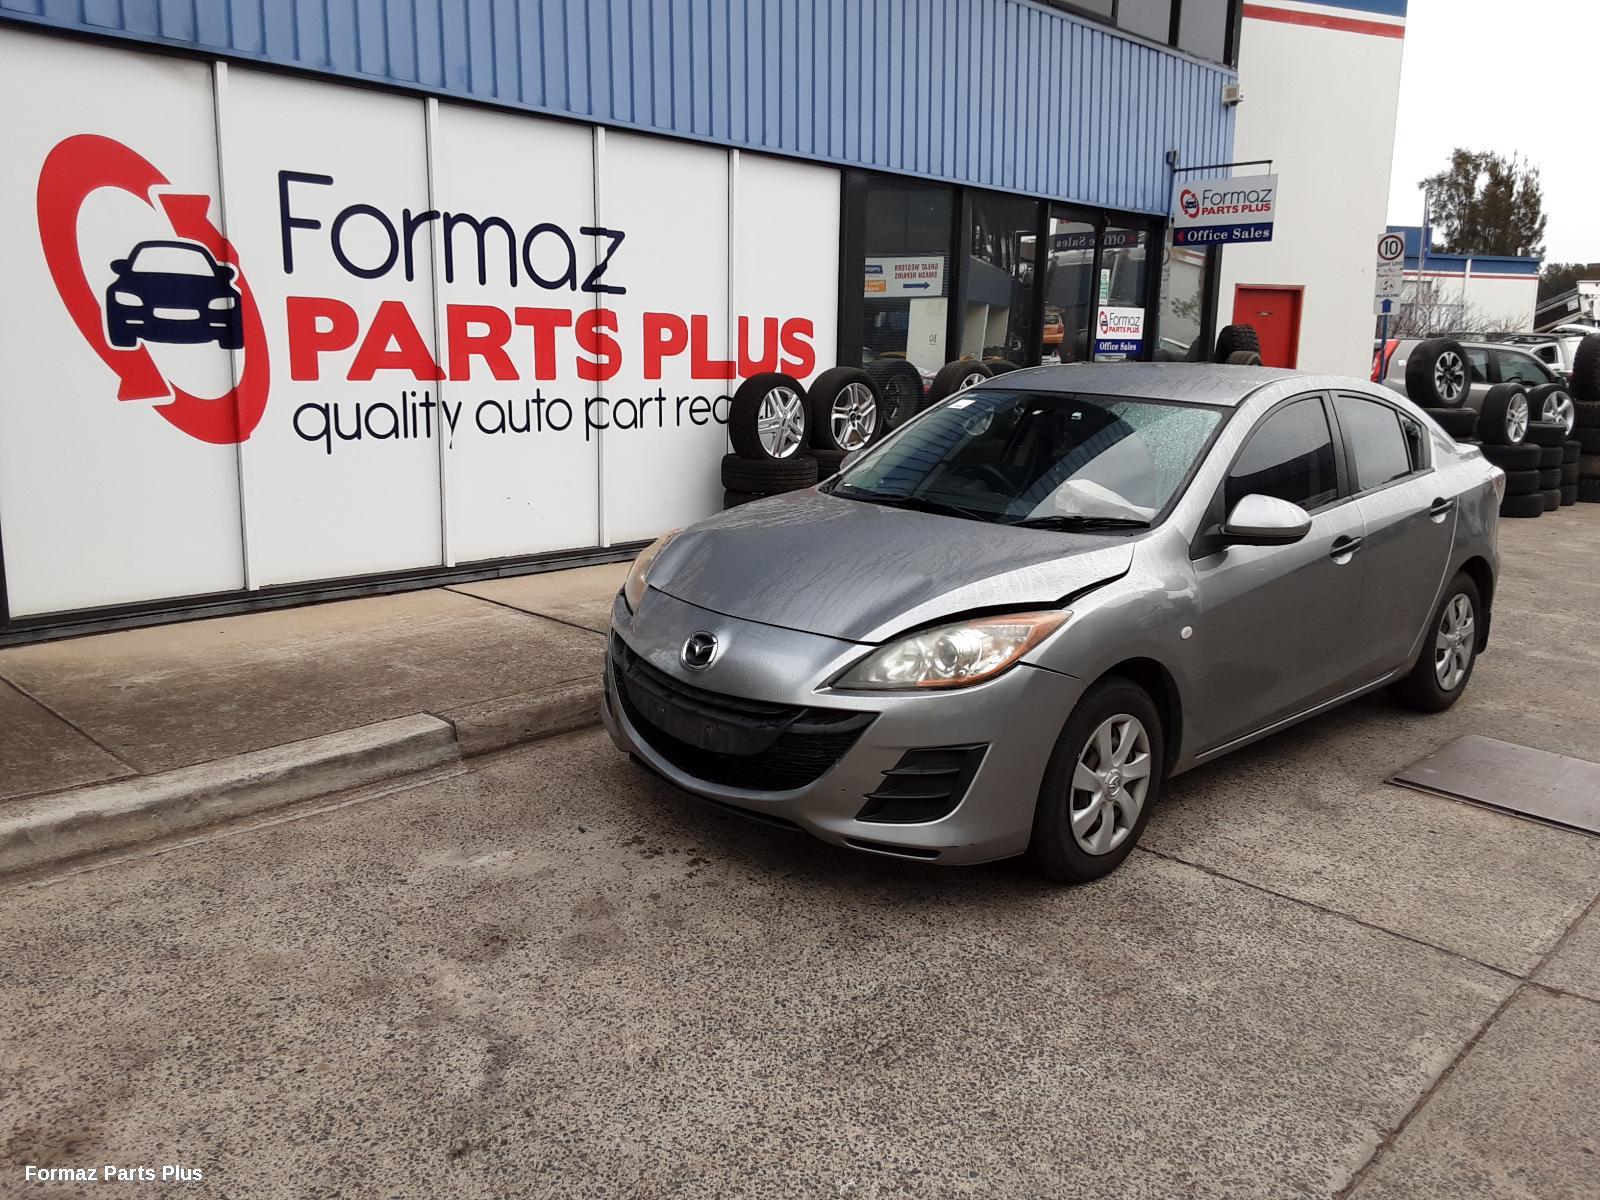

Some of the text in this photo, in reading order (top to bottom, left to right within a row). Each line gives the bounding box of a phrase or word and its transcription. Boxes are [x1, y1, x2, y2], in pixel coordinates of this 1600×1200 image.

[1202, 189, 1272, 206] Formaz
[1201, 203, 1271, 215] PARTS PLUS
[279, 170, 626, 295] Formaz
[1187, 227, 1270, 241] Office Sales
[1385, 240, 1398, 255] 10
[1109, 312, 1141, 327] Formaz
[286, 296, 816, 381] PARTS PLUS
[1099, 341, 1137, 351] Office Sales
[292, 390, 462, 454] quality
[475, 388, 573, 434] auto
[585, 388, 666, 441] part
